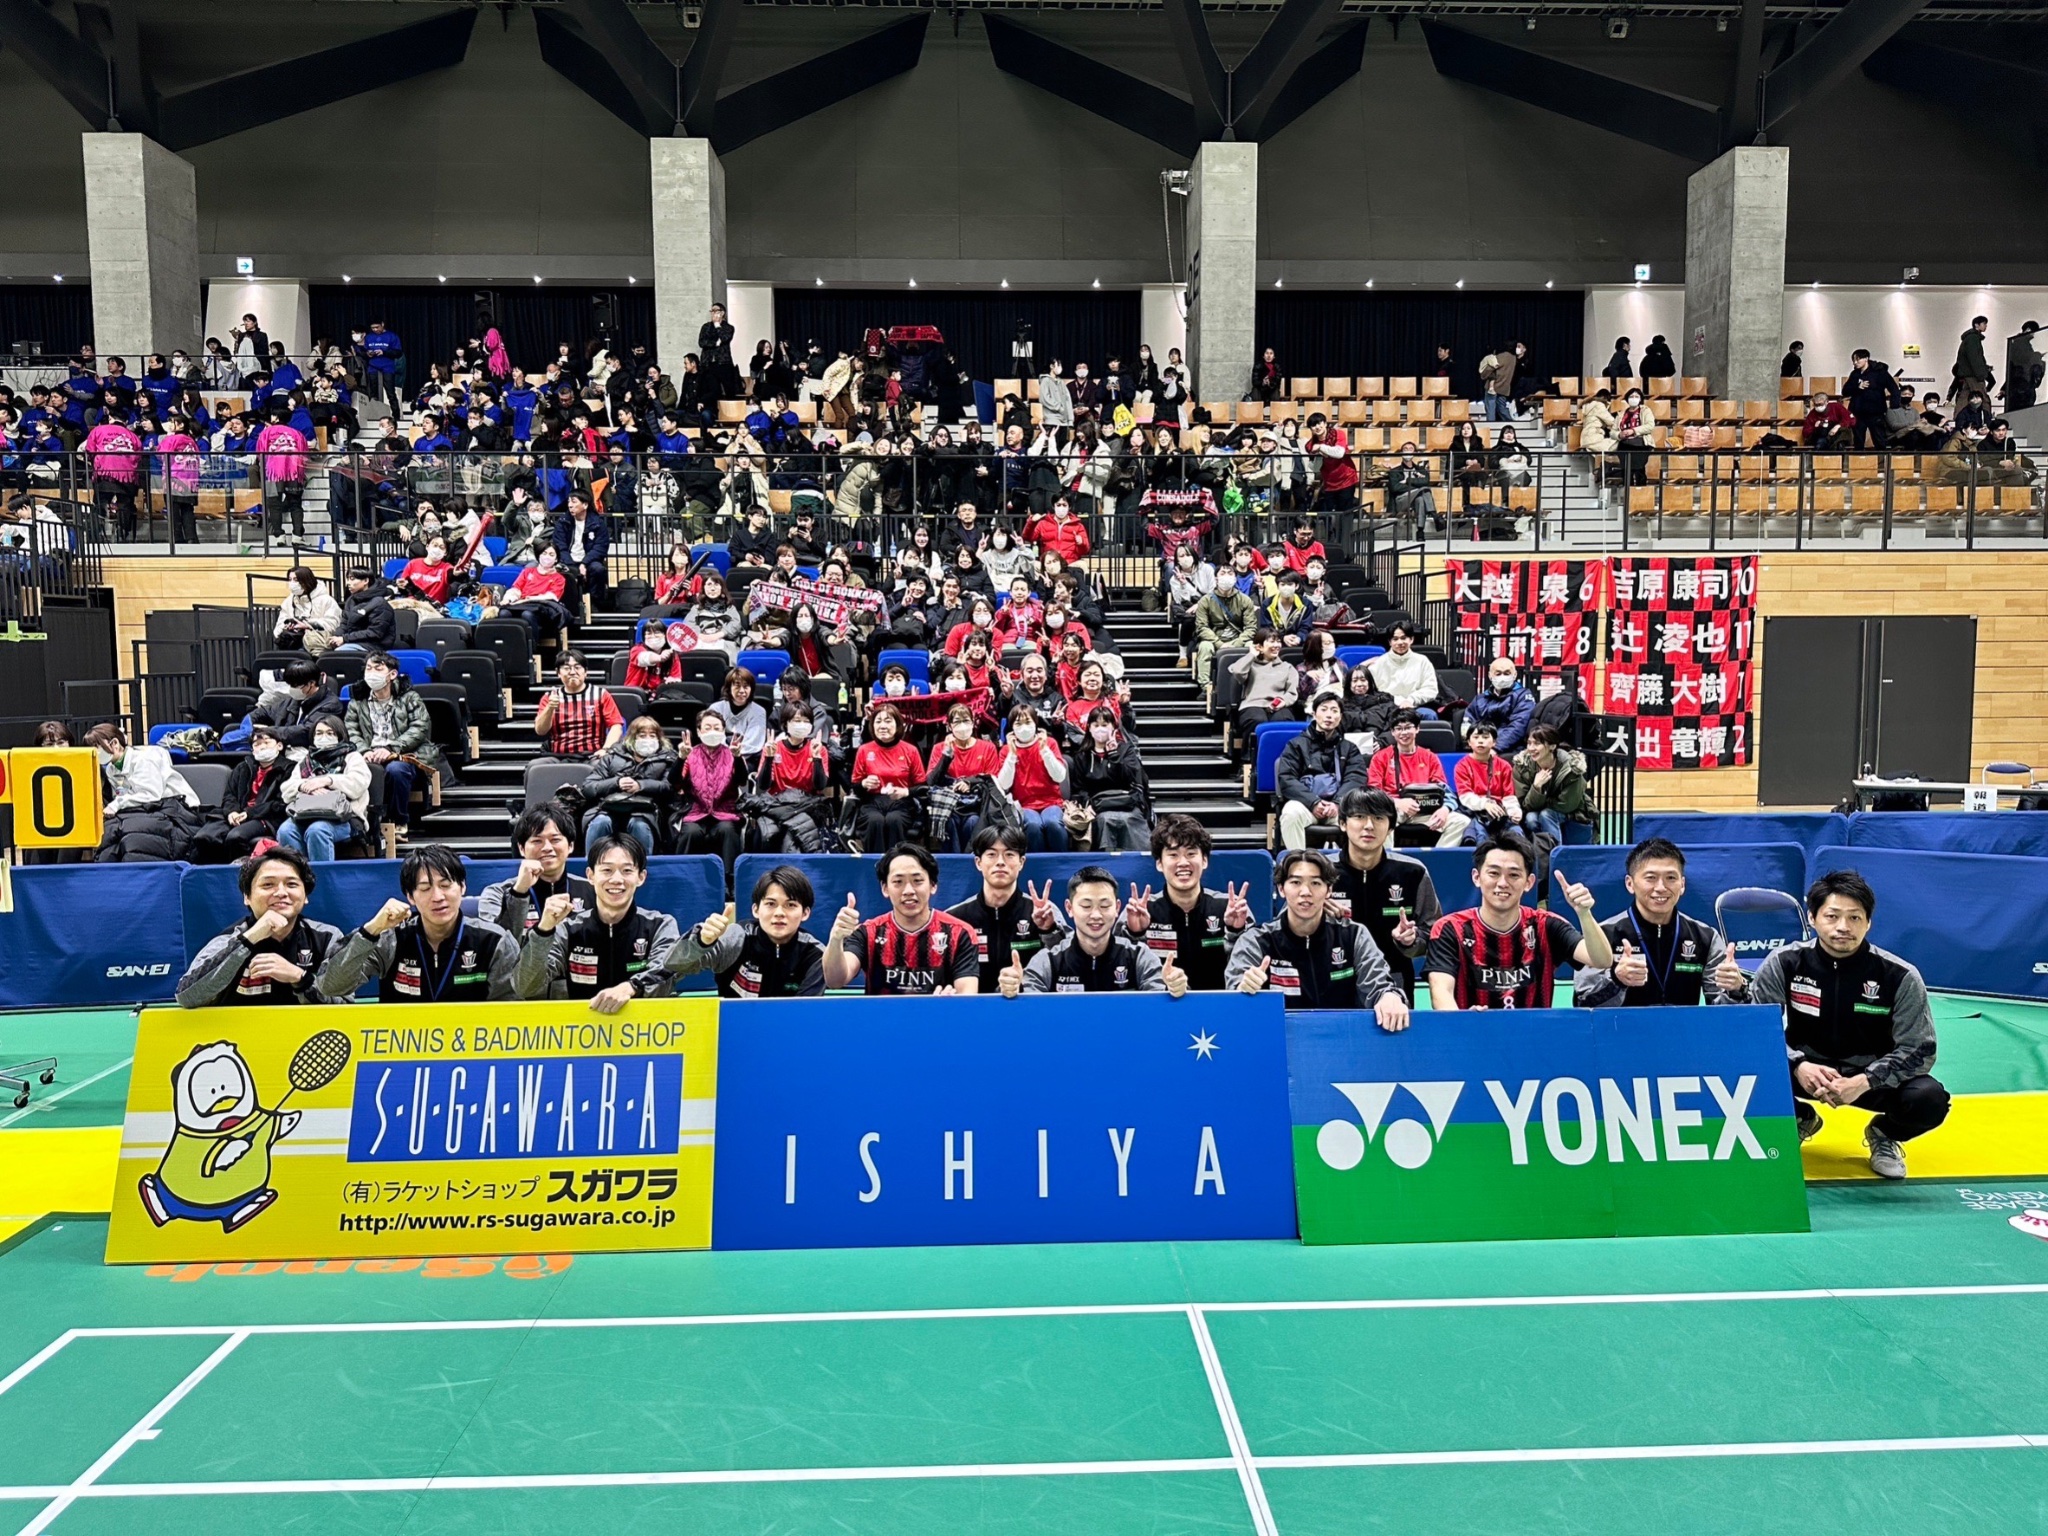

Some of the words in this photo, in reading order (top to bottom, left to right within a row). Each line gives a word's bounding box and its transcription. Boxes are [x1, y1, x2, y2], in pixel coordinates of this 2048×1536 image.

[1454, 572, 1514, 604] 大越
[1539, 573, 1570, 604] 泉
[1579, 573, 1594, 601] 6
[1733, 566, 1755, 597] 10
[1575, 626, 1591, 655] 8
[1734, 620, 1752, 650] 11
[1670, 672, 1727, 705] 大樹
[1737, 671, 1745, 699] 1
[1733, 725, 1745, 753] 2
[32, 766, 75, 836] 0
[1735, 938, 1785, 951] SAN-EI
[106, 963, 171, 978] SAN-EI
[1503, 996, 1515, 1009] 8
[360, 1027, 444, 1054] TENNIS
[451, 1027, 466, 1053] &
[473, 1024, 613, 1052] BADMINTON
[619, 1022, 686, 1048] SHOP
[1483, 1075, 1768, 1166] YONEX
[785, 1126, 1226, 1204] ISHIYA
[547, 1168, 678, 1203] スガワラ
[339, 1206, 676, 1235] http://www.rs-sugawara.co.jp
